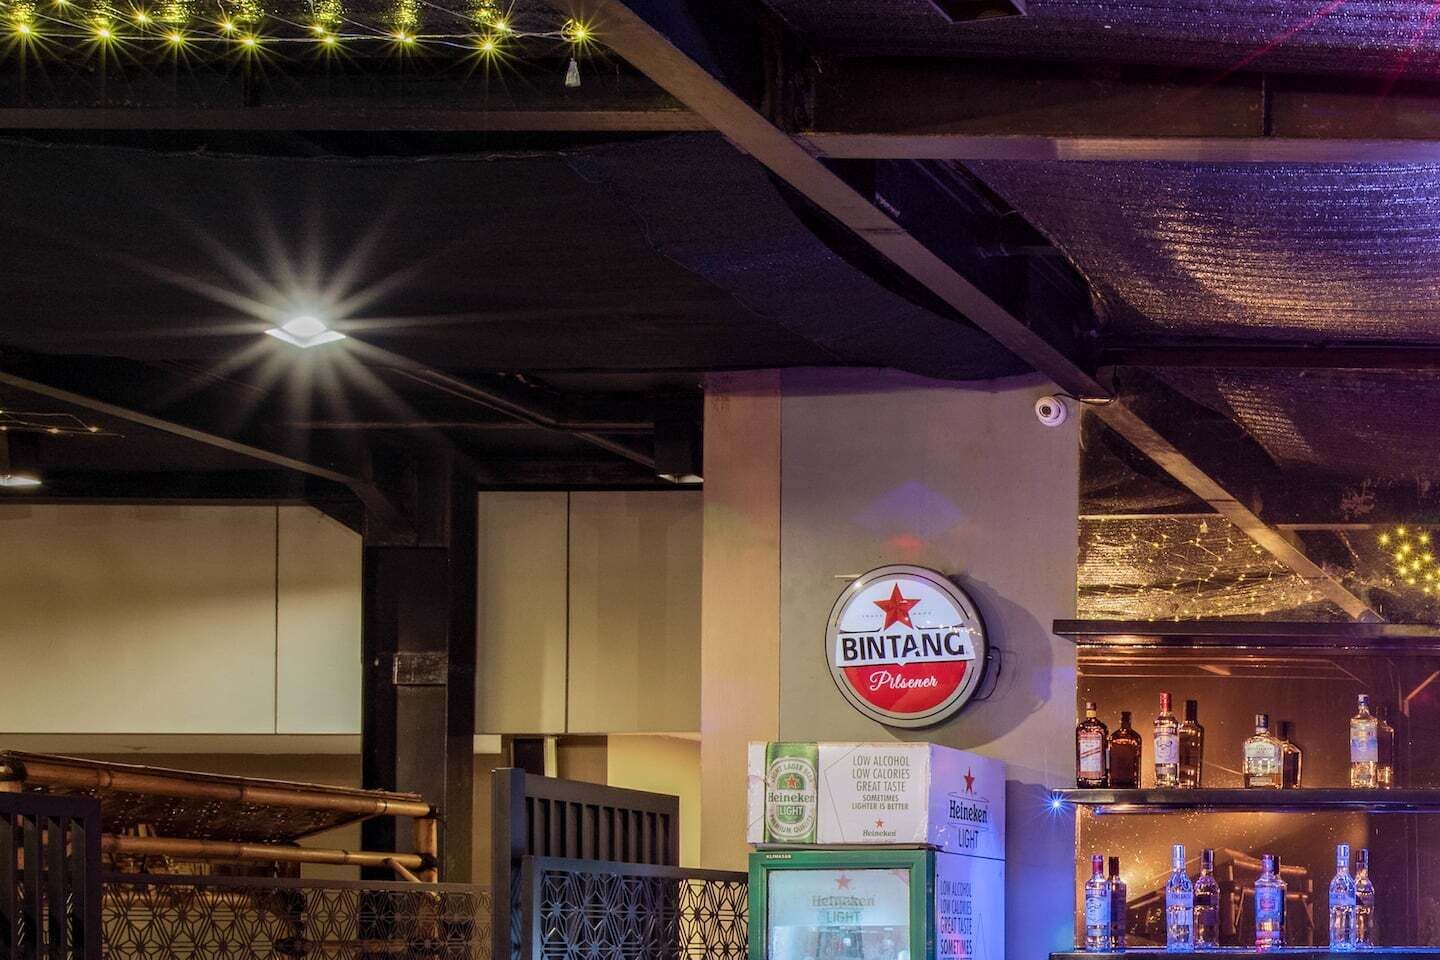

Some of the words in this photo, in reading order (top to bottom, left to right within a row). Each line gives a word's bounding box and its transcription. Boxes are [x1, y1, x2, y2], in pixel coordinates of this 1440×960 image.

[842, 632, 965, 662] BINTANG
[869, 670, 938, 692] Pilsener
[852, 755, 870, 767] LOW
[873, 755, 911, 767] ALCOHOL
[851, 768, 870, 780] LOW
[872, 768, 912, 780] CALORIES
[856, 781, 881, 793] GREAT
[884, 781, 906, 793] TASTE
[767, 791, 816, 803] Heineken
[862, 794, 900, 802] SOMETIMES
[779, 805, 804, 816] LIGHT
[851, 802, 878, 810] LIGHTER
[887, 803, 909, 811] BETTER
[948, 799, 988, 824] Heineken
[862, 829, 897, 838] Heineken
[958, 828, 980, 849] LIGHT
[825, 911, 861, 924] LIGHT
